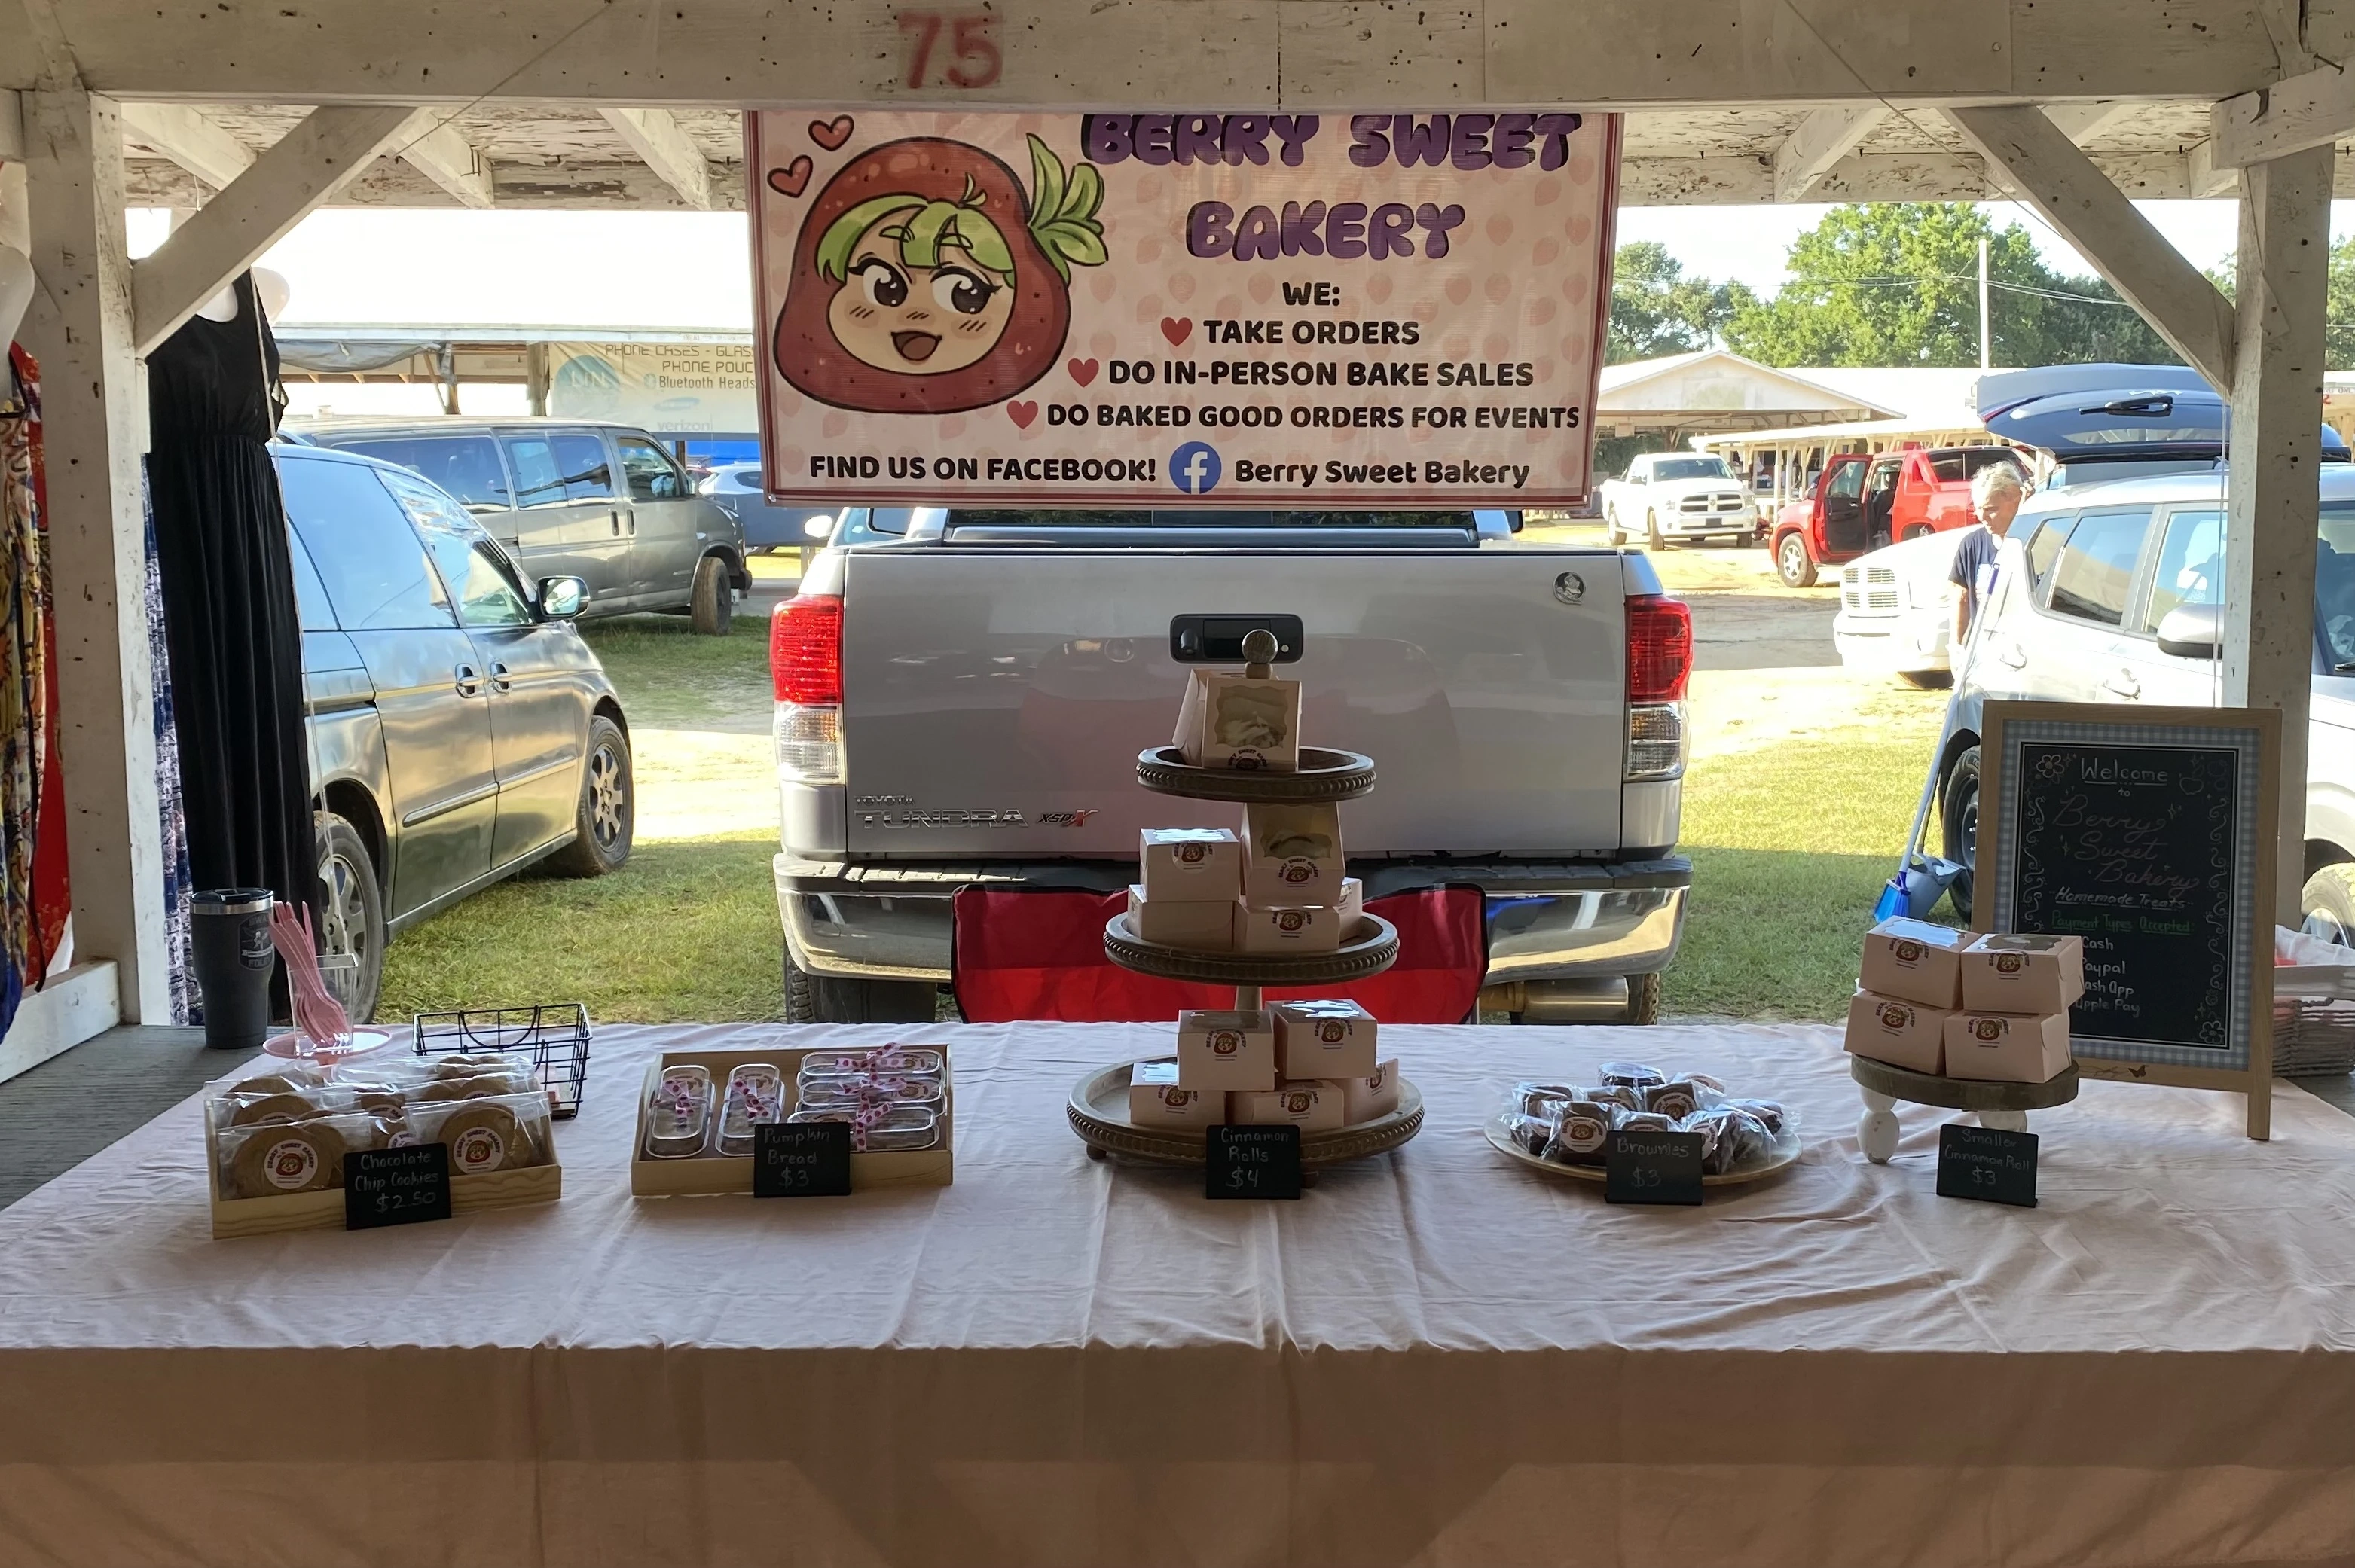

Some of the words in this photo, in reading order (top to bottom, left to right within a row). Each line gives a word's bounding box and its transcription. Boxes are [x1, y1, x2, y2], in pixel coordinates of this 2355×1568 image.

[897, 11, 1003, 89] 75
[1081, 113, 1319, 167] BERRY
[1348, 113, 1582, 171] SWEET
[1186, 200, 1466, 261] BAKERY
[1282, 282, 1340, 307] WE:
[1203, 319, 1284, 344] TAKE
[1292, 320, 1420, 345] ORDERS
[605, 343, 650, 356] PHONE
[655, 344, 700, 356] CASES
[716, 346, 754, 357] GLAS
[662, 361, 710, 372] PHONE
[1109, 360, 1156, 385] DO
[1164, 361, 1338, 386] IN-PERSON
[1346, 362, 1429, 386] BAKE
[1437, 362, 1534, 386] SALES
[659, 375, 713, 389] Bluetooth
[657, 419, 710, 432] verizon
[1047, 404, 1089, 426] DO
[1096, 404, 1192, 427] BAKED
[1199, 405, 1283, 428] GOOD
[1290, 406, 1404, 428] ORDERS
[1411, 407, 1467, 428] FOR
[1474, 407, 1579, 429] EVENTS
[810, 456, 880, 478] FIND
[888, 456, 927, 479] US
[933, 457, 978, 480] ON
[987, 457, 1156, 482] FACEBOOK!
[1236, 459, 1318, 488] Berry
[1325, 460, 1416, 483] Sweet
[1425, 460, 1530, 489] Bakery
[2081, 757, 2168, 782] Welcome
[853, 794, 917, 807] TOYOTA
[2118, 787, 2131, 798] to
[854, 809, 1029, 829] TUNDRA
[2051, 794, 2167, 843] Berry
[2074, 831, 2168, 861] Sweet
[2094, 859, 2200, 897] Bakery
[2054, 886, 2134, 906] Homemade
[2139, 893, 2185, 910] Treats
[2051, 910, 2100, 930] Payment
[2103, 914, 2134, 932] Types
[2082, 935, 2114, 950] Cash
[2085, 979, 2106, 993] ash
[2114, 998, 2140, 1018] Pay
[765, 1127, 829, 1148] Pumpkin
[1221, 1127, 1289, 1142] Cinnamon
[1962, 1129, 2018, 1147] Smaller
[768, 1149, 817, 1165] Bread
[1229, 1145, 1269, 1163] Rolls
[1617, 1136, 1689, 1158] Brownies
[1944, 1143, 2003, 1167] Cinnamon
[2005, 1155, 2030, 1171] Roll
[360, 1152, 432, 1170] Chocolate
[355, 1174, 385, 1192] Chip
[390, 1170, 439, 1187] Cookies
[778, 1166, 810, 1189] $3
[1226, 1165, 1259, 1189] $4
[1631, 1167, 1662, 1188] $3
[1972, 1165, 1996, 1185] $3
